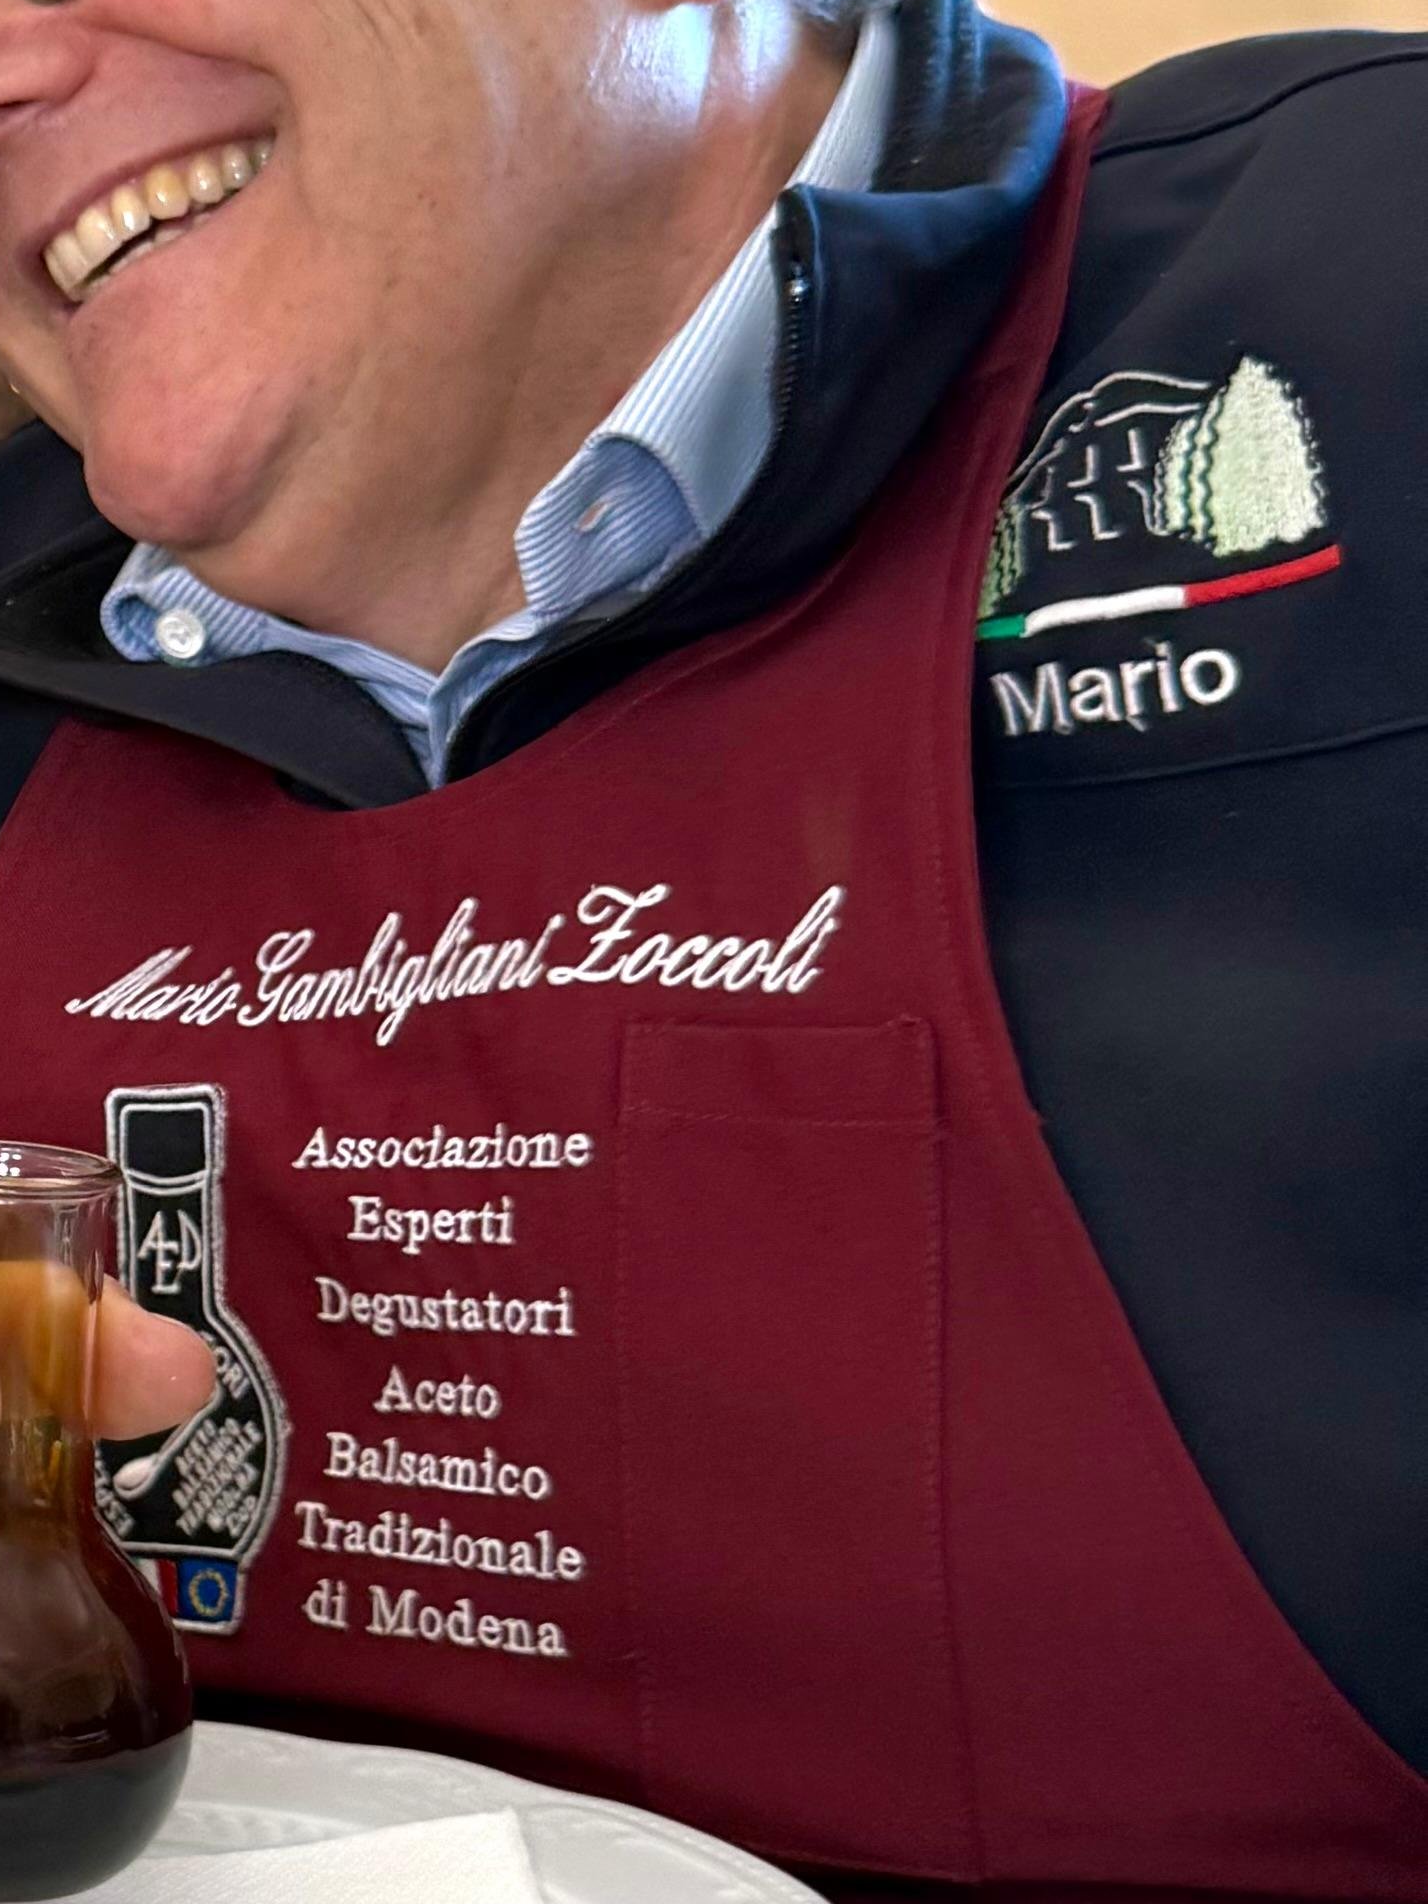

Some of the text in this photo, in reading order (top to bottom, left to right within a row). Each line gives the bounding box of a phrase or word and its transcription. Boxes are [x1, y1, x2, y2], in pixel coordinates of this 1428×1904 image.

[991, 639, 1239, 737] Mario
[64, 883, 847, 1047] Mario Gambigliani Zoccoli
[291, 1122, 593, 1171] Associazione
[347, 1195, 515, 1255] Esperti
[315, 1276, 576, 1338] Degustatori
[372, 1365, 502, 1420] Aceto
[323, 1432, 551, 1501] Balsamico
[295, 1501, 586, 1581] Tradizionale
[301, 1578, 570, 1659] di Modena
